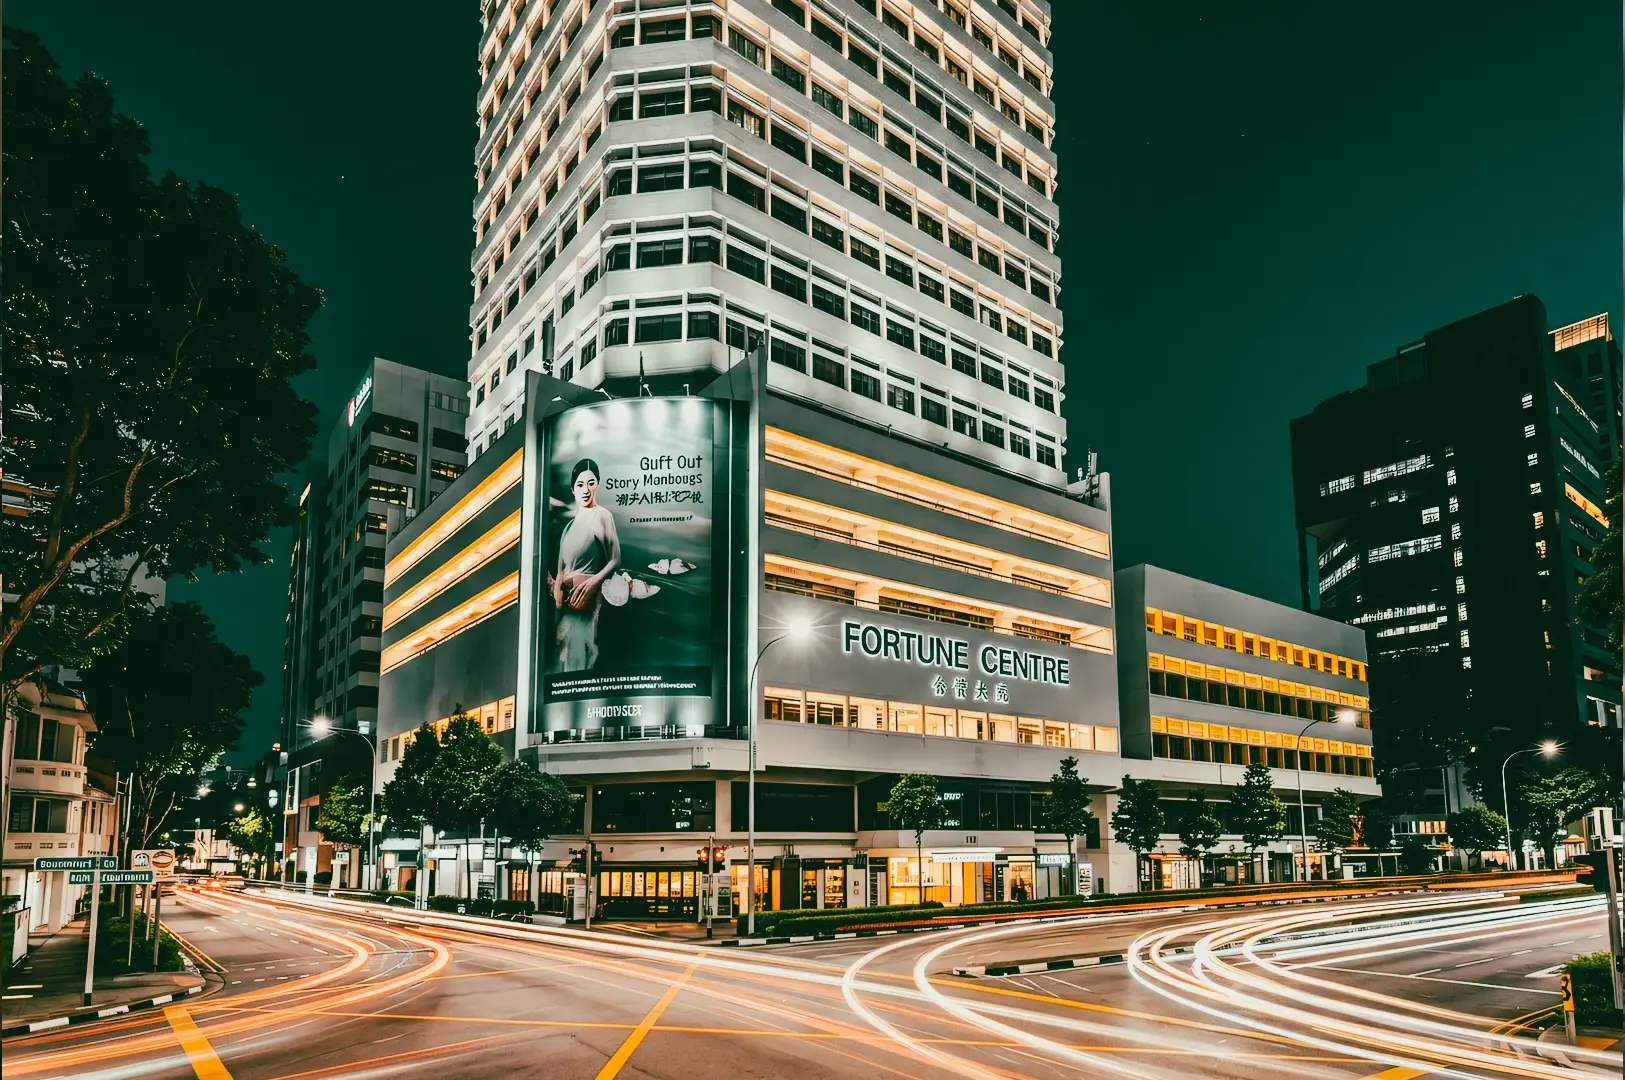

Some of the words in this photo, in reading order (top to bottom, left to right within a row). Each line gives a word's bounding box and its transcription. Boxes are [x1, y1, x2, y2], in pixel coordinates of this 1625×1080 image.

[678, 454, 704, 469] Out
[605, 477, 640, 491] Story
[844, 621, 970, 671] FORTUNE
[981, 646, 1071, 685] CENTRE
